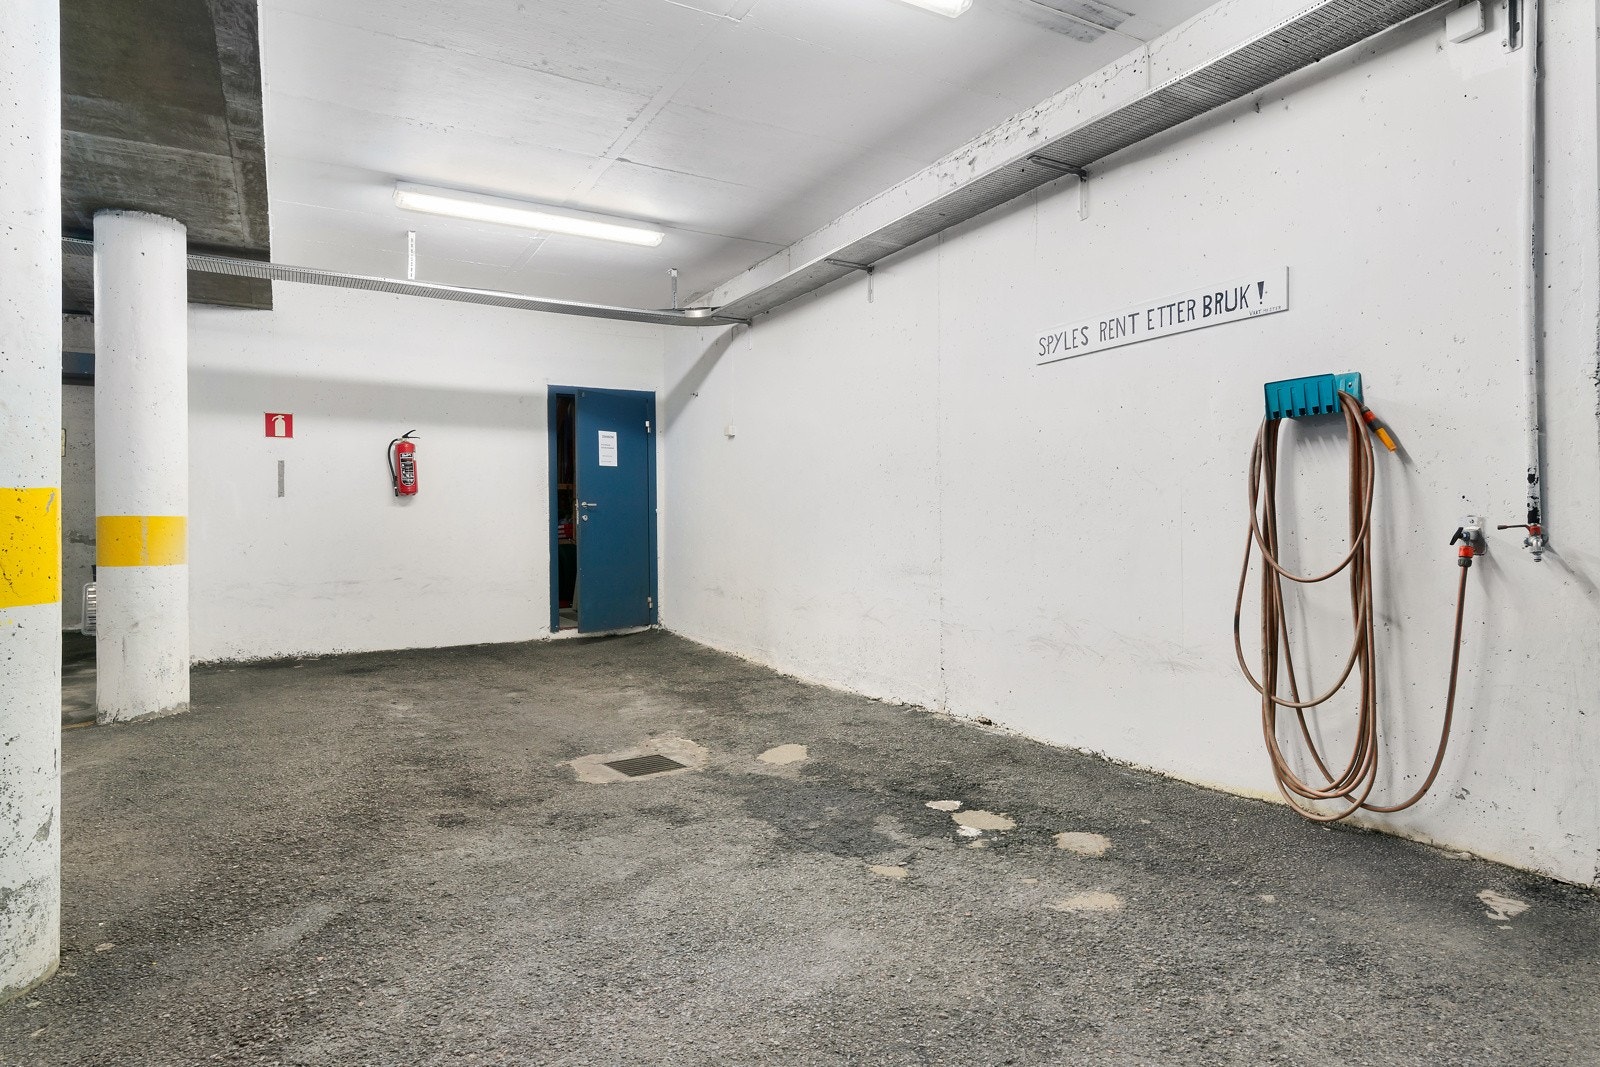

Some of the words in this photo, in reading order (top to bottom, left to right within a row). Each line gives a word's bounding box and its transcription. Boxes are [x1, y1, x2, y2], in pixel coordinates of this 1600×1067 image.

[1038, 325, 1088, 357] SPYLES
[1099, 312, 1140, 342] RENT
[1148, 298, 1196, 330] ETTER
